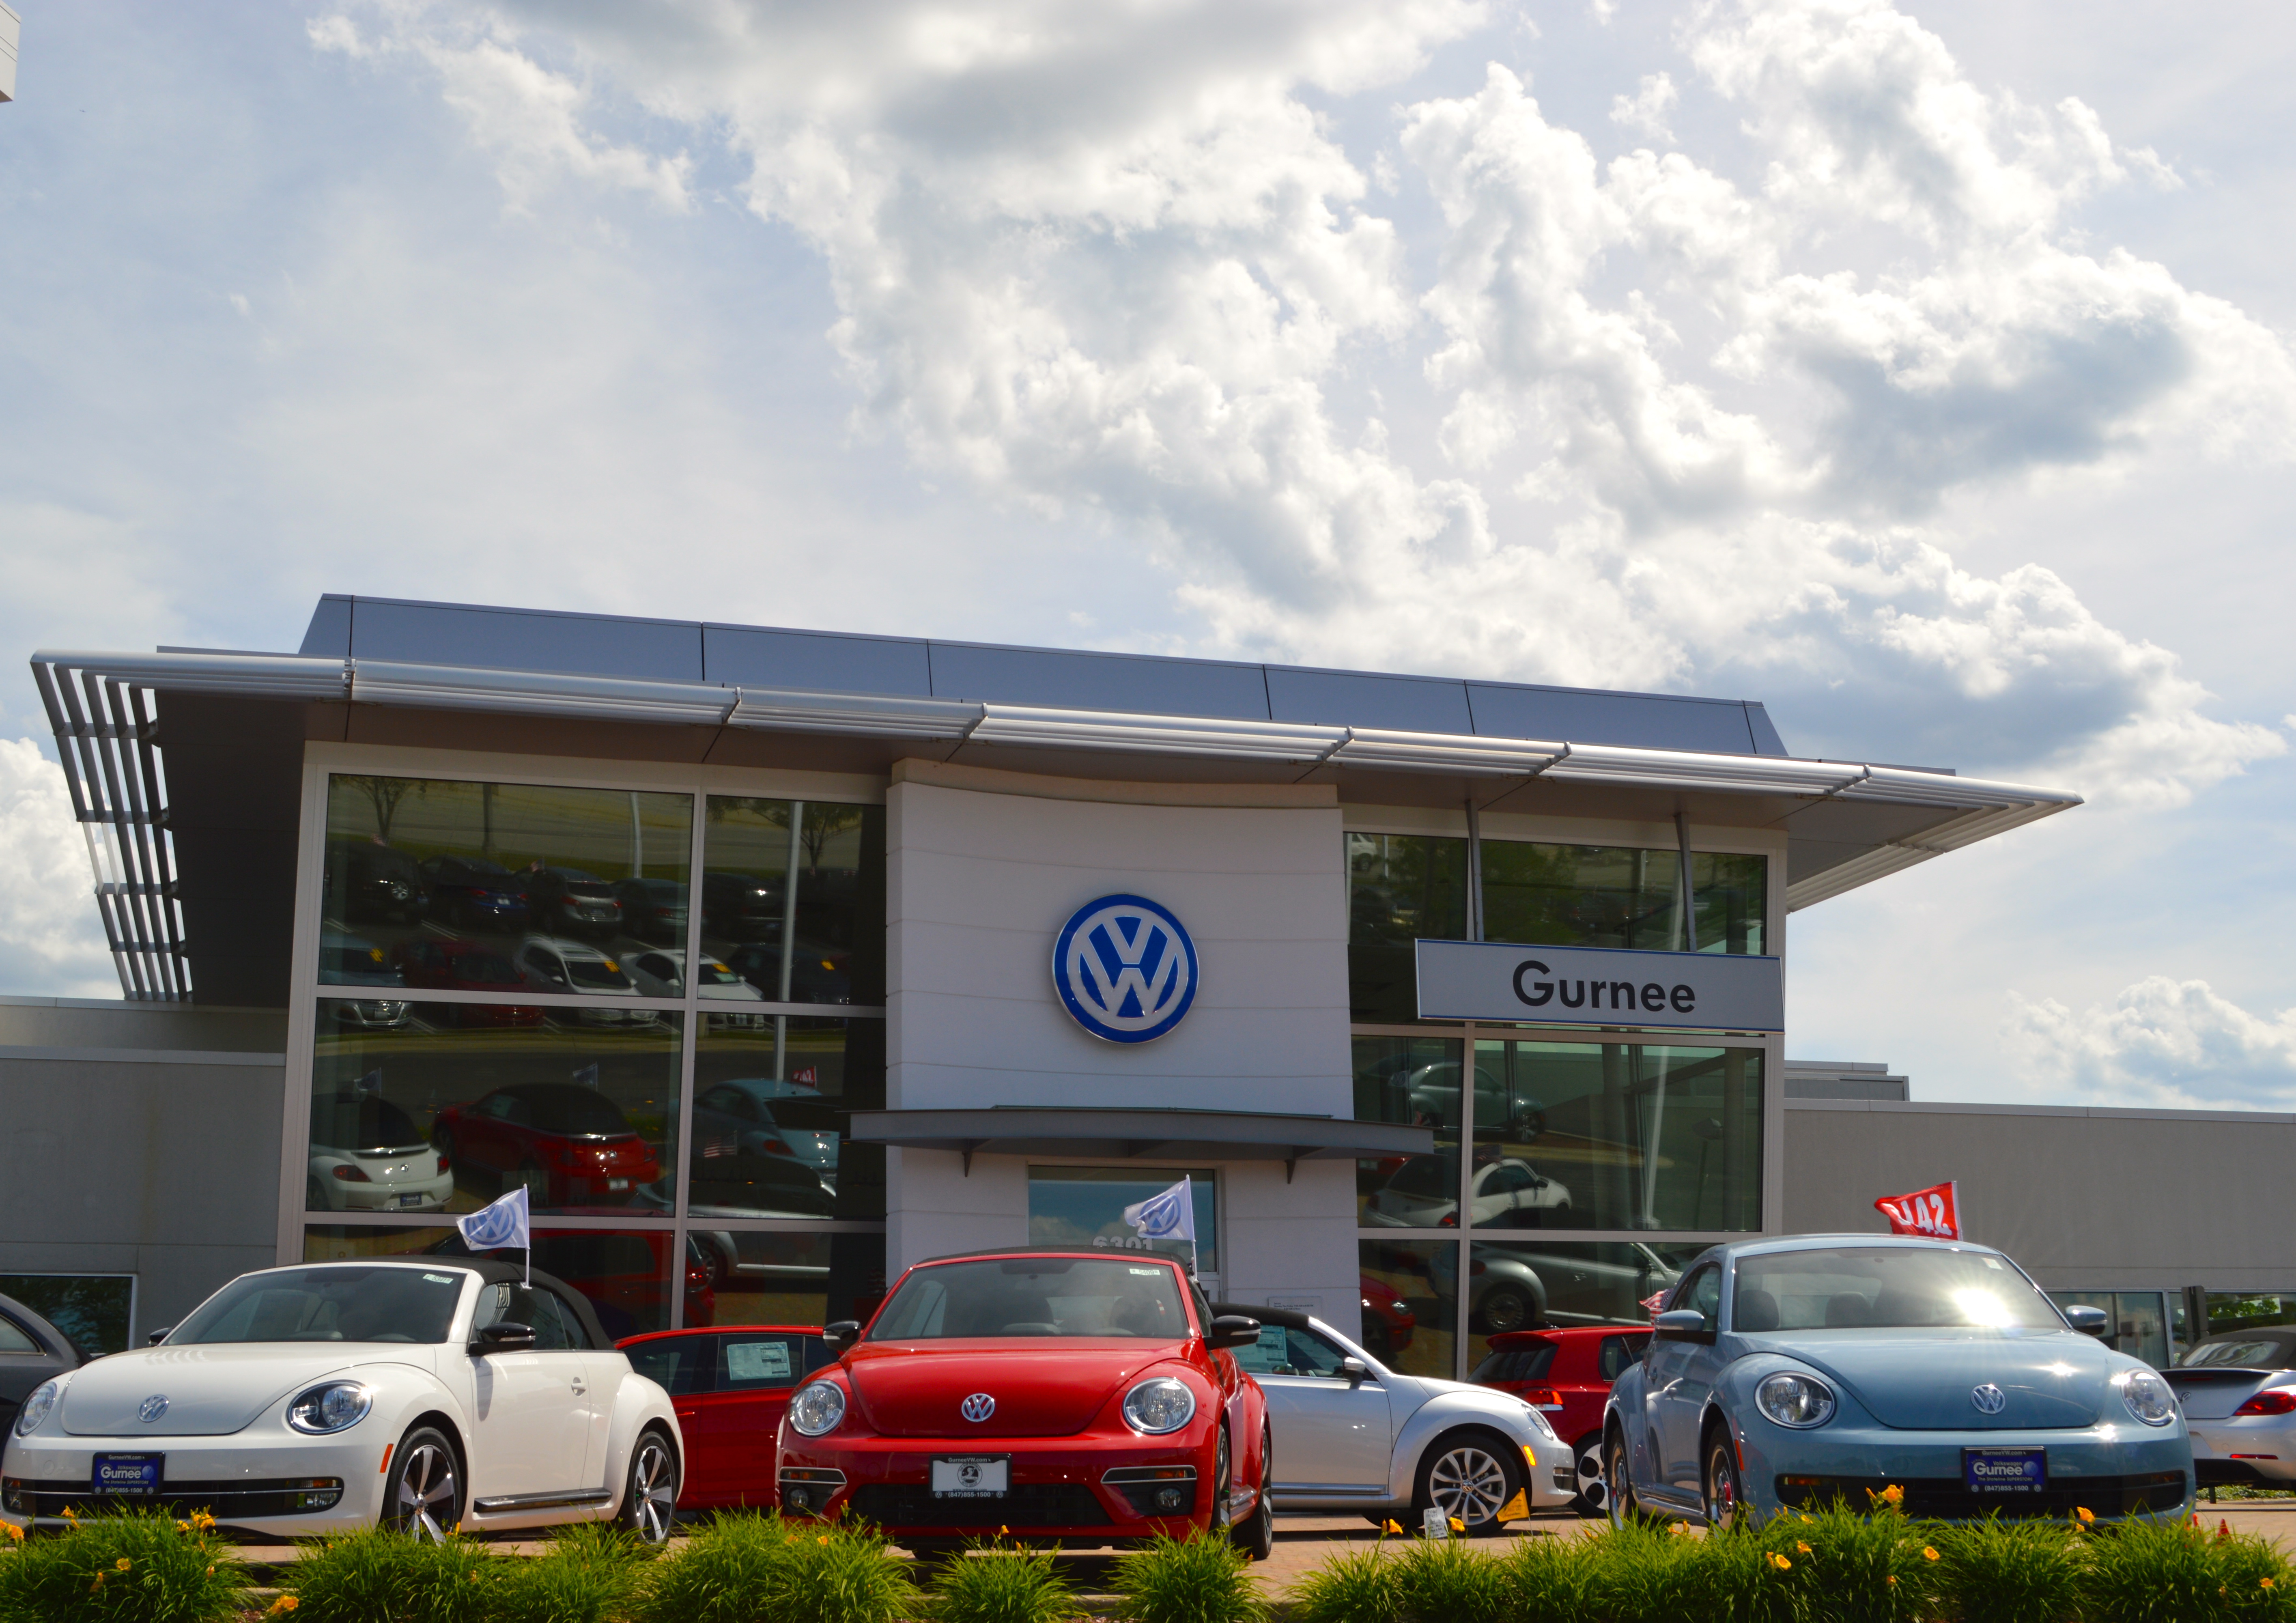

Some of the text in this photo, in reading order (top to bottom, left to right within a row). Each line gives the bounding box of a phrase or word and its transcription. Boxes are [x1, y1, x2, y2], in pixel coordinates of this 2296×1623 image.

[1513, 960, 1696, 1013] Gurnee
[101, 1466, 141, 1479] Gurnee
[1973, 1462, 2023, 1475] Gurnee
